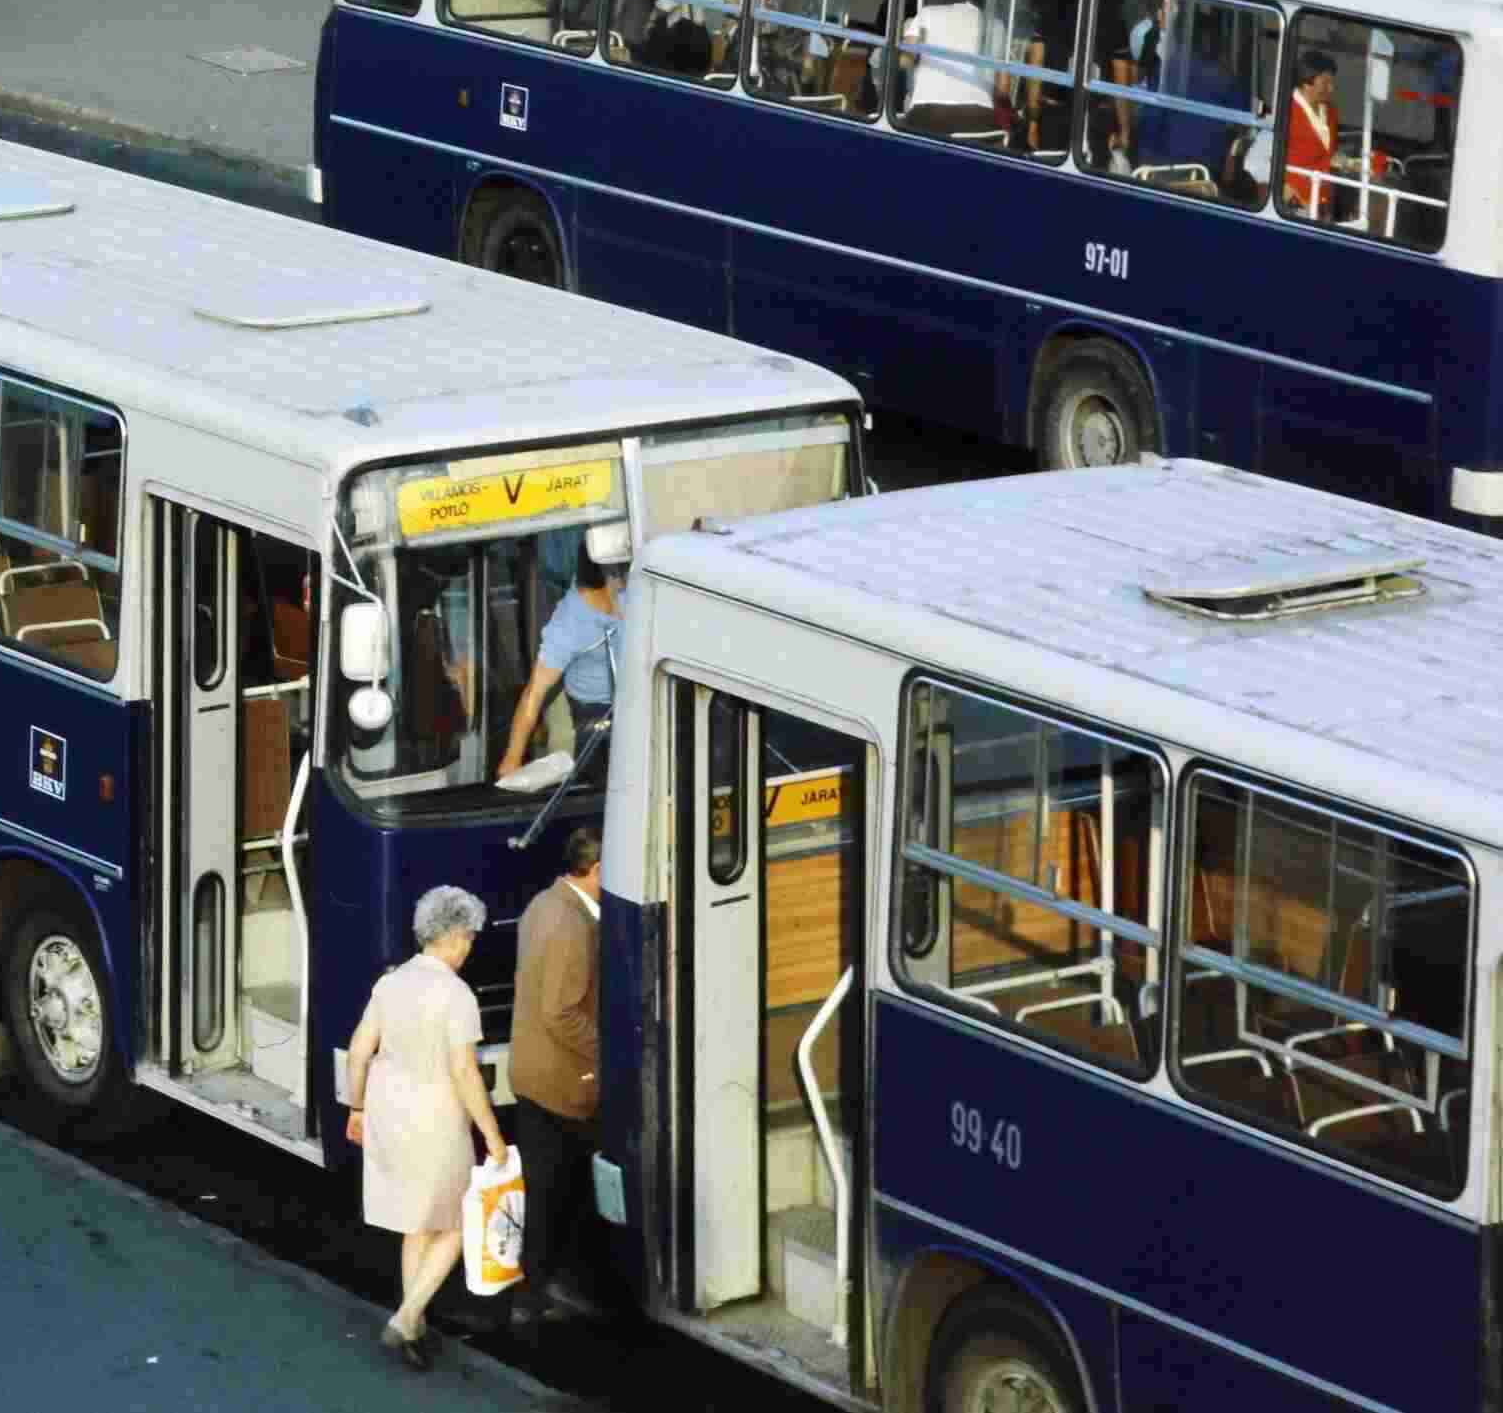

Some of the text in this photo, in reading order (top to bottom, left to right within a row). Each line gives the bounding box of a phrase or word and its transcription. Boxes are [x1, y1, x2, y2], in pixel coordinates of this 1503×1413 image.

[1084, 241, 1129, 280] 97-01
[501, 473, 525, 505] V
[31, 771, 65, 796] BKV
